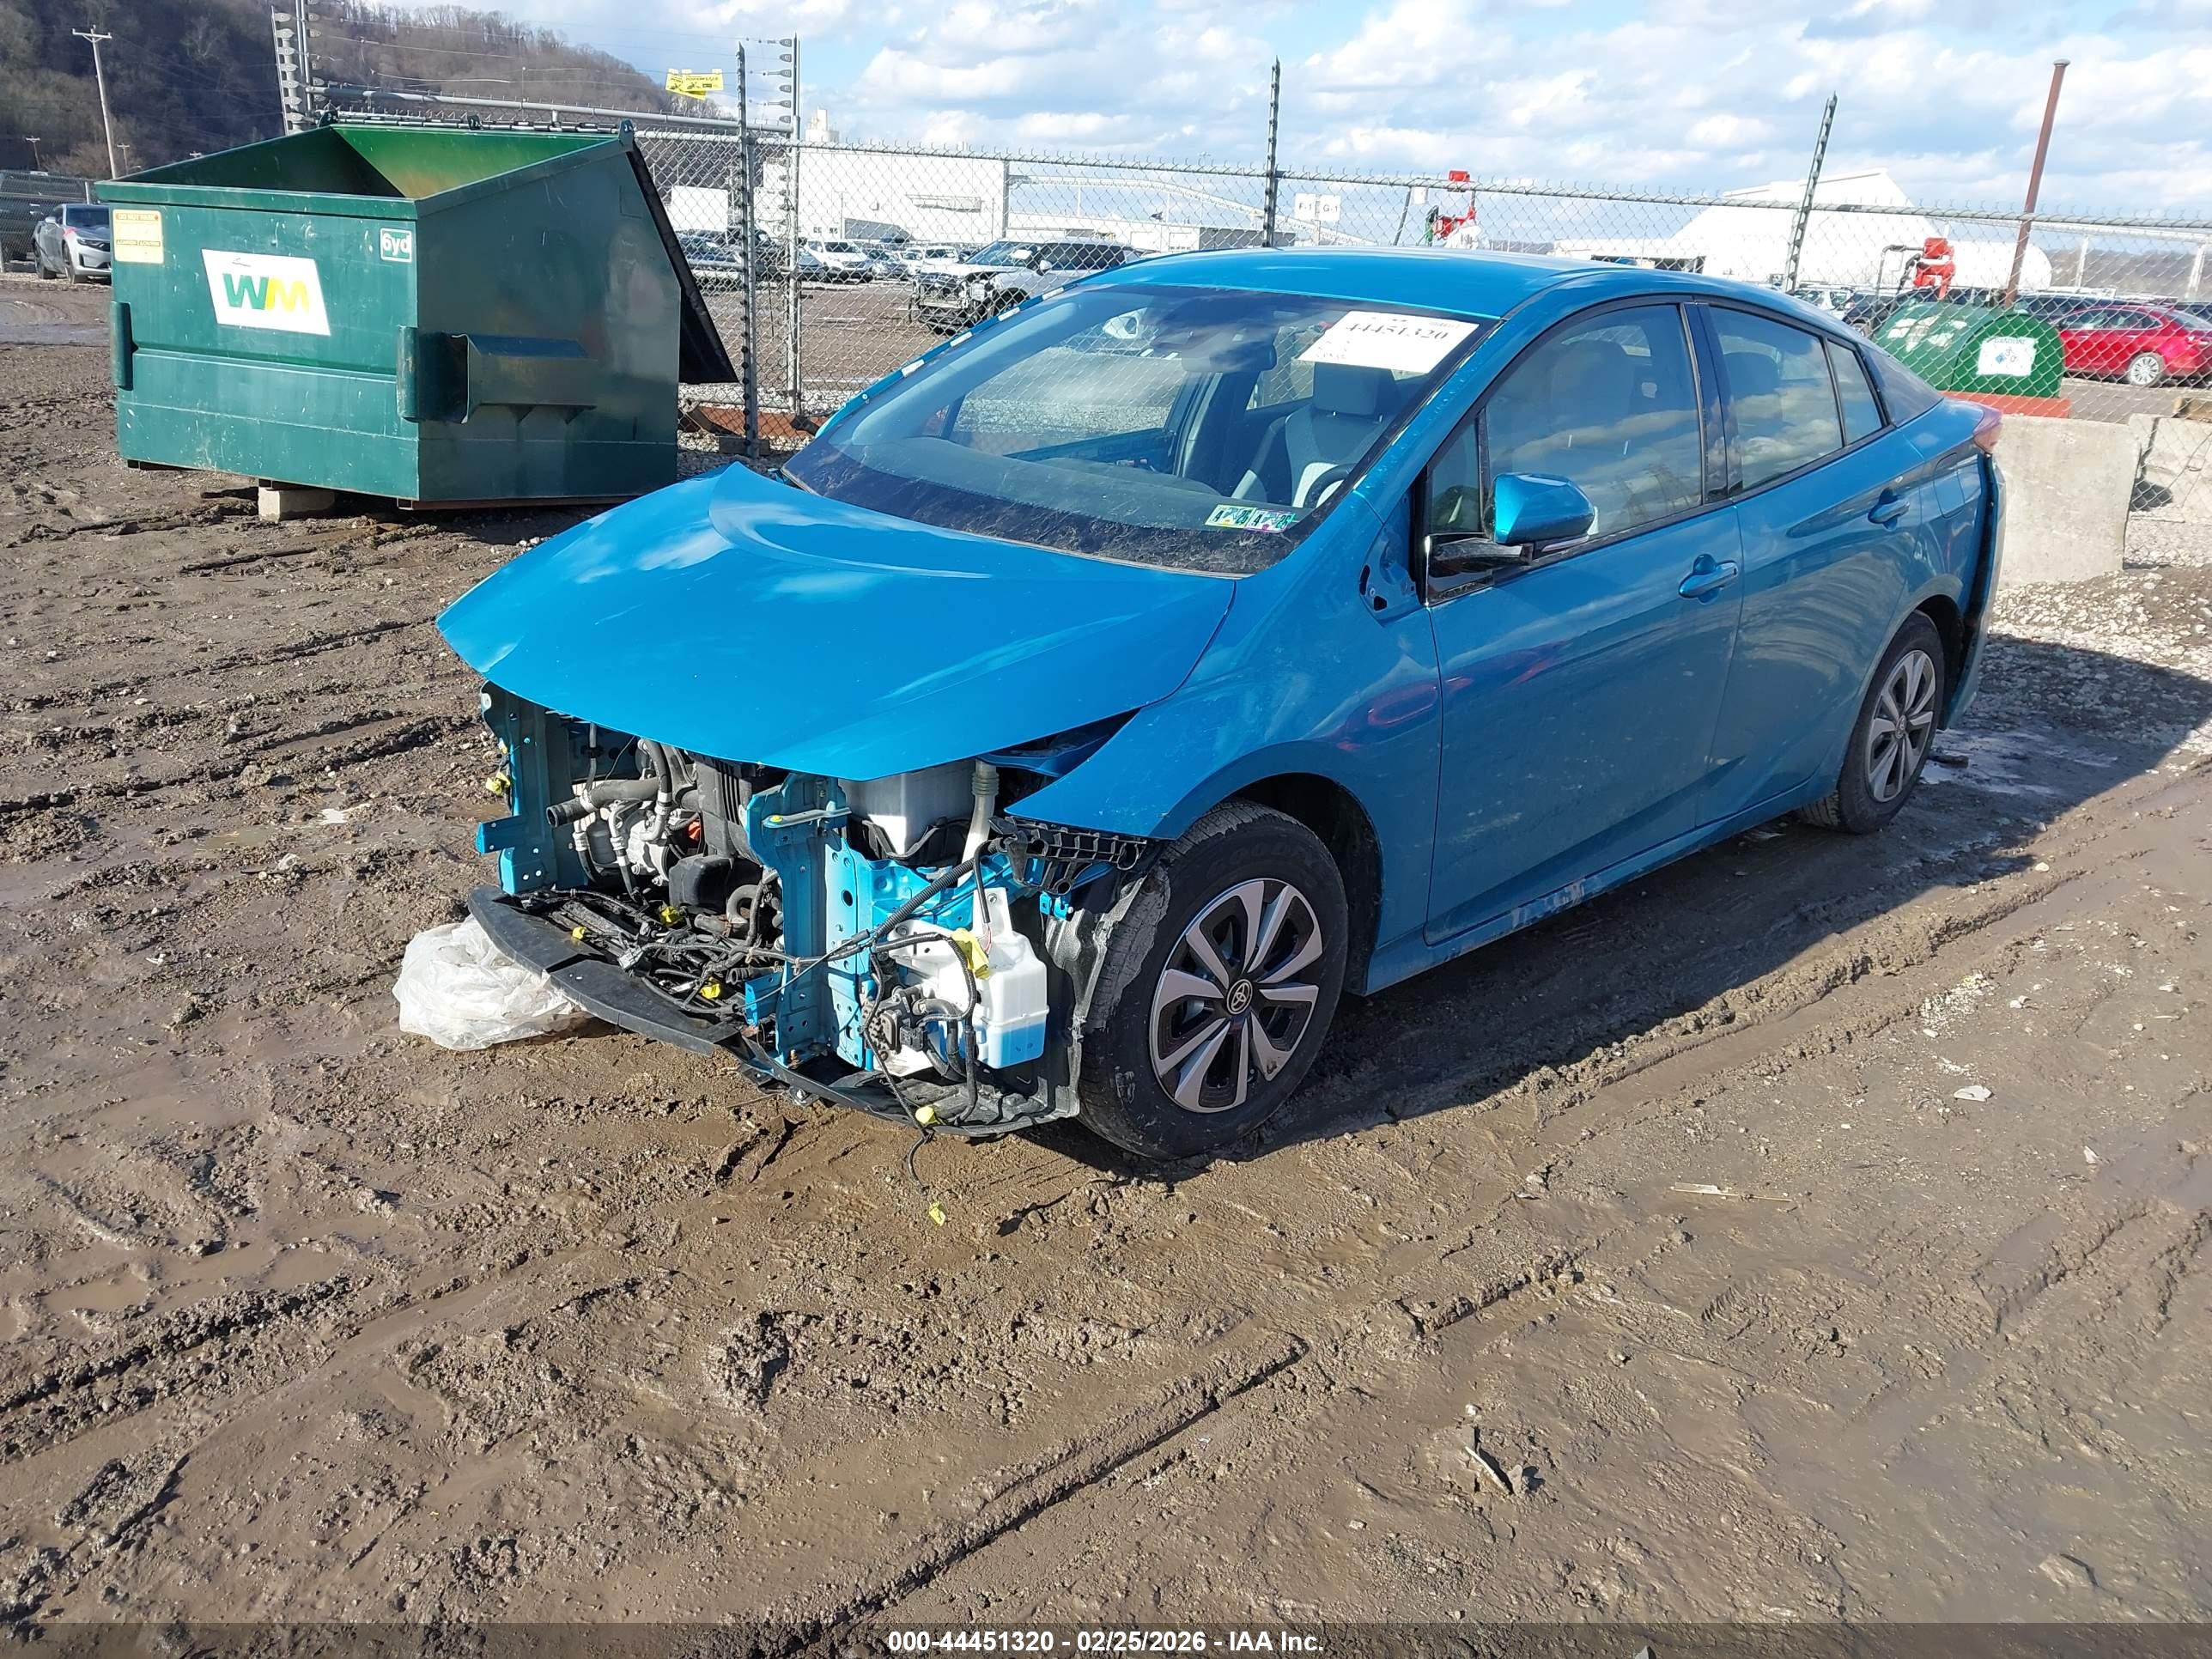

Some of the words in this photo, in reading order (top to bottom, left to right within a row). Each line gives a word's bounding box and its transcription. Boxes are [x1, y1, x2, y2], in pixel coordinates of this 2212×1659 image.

[383, 232, 411, 256] 6yd
[222, 273, 310, 313] WM
[1346, 322, 1449, 340] 44451320
